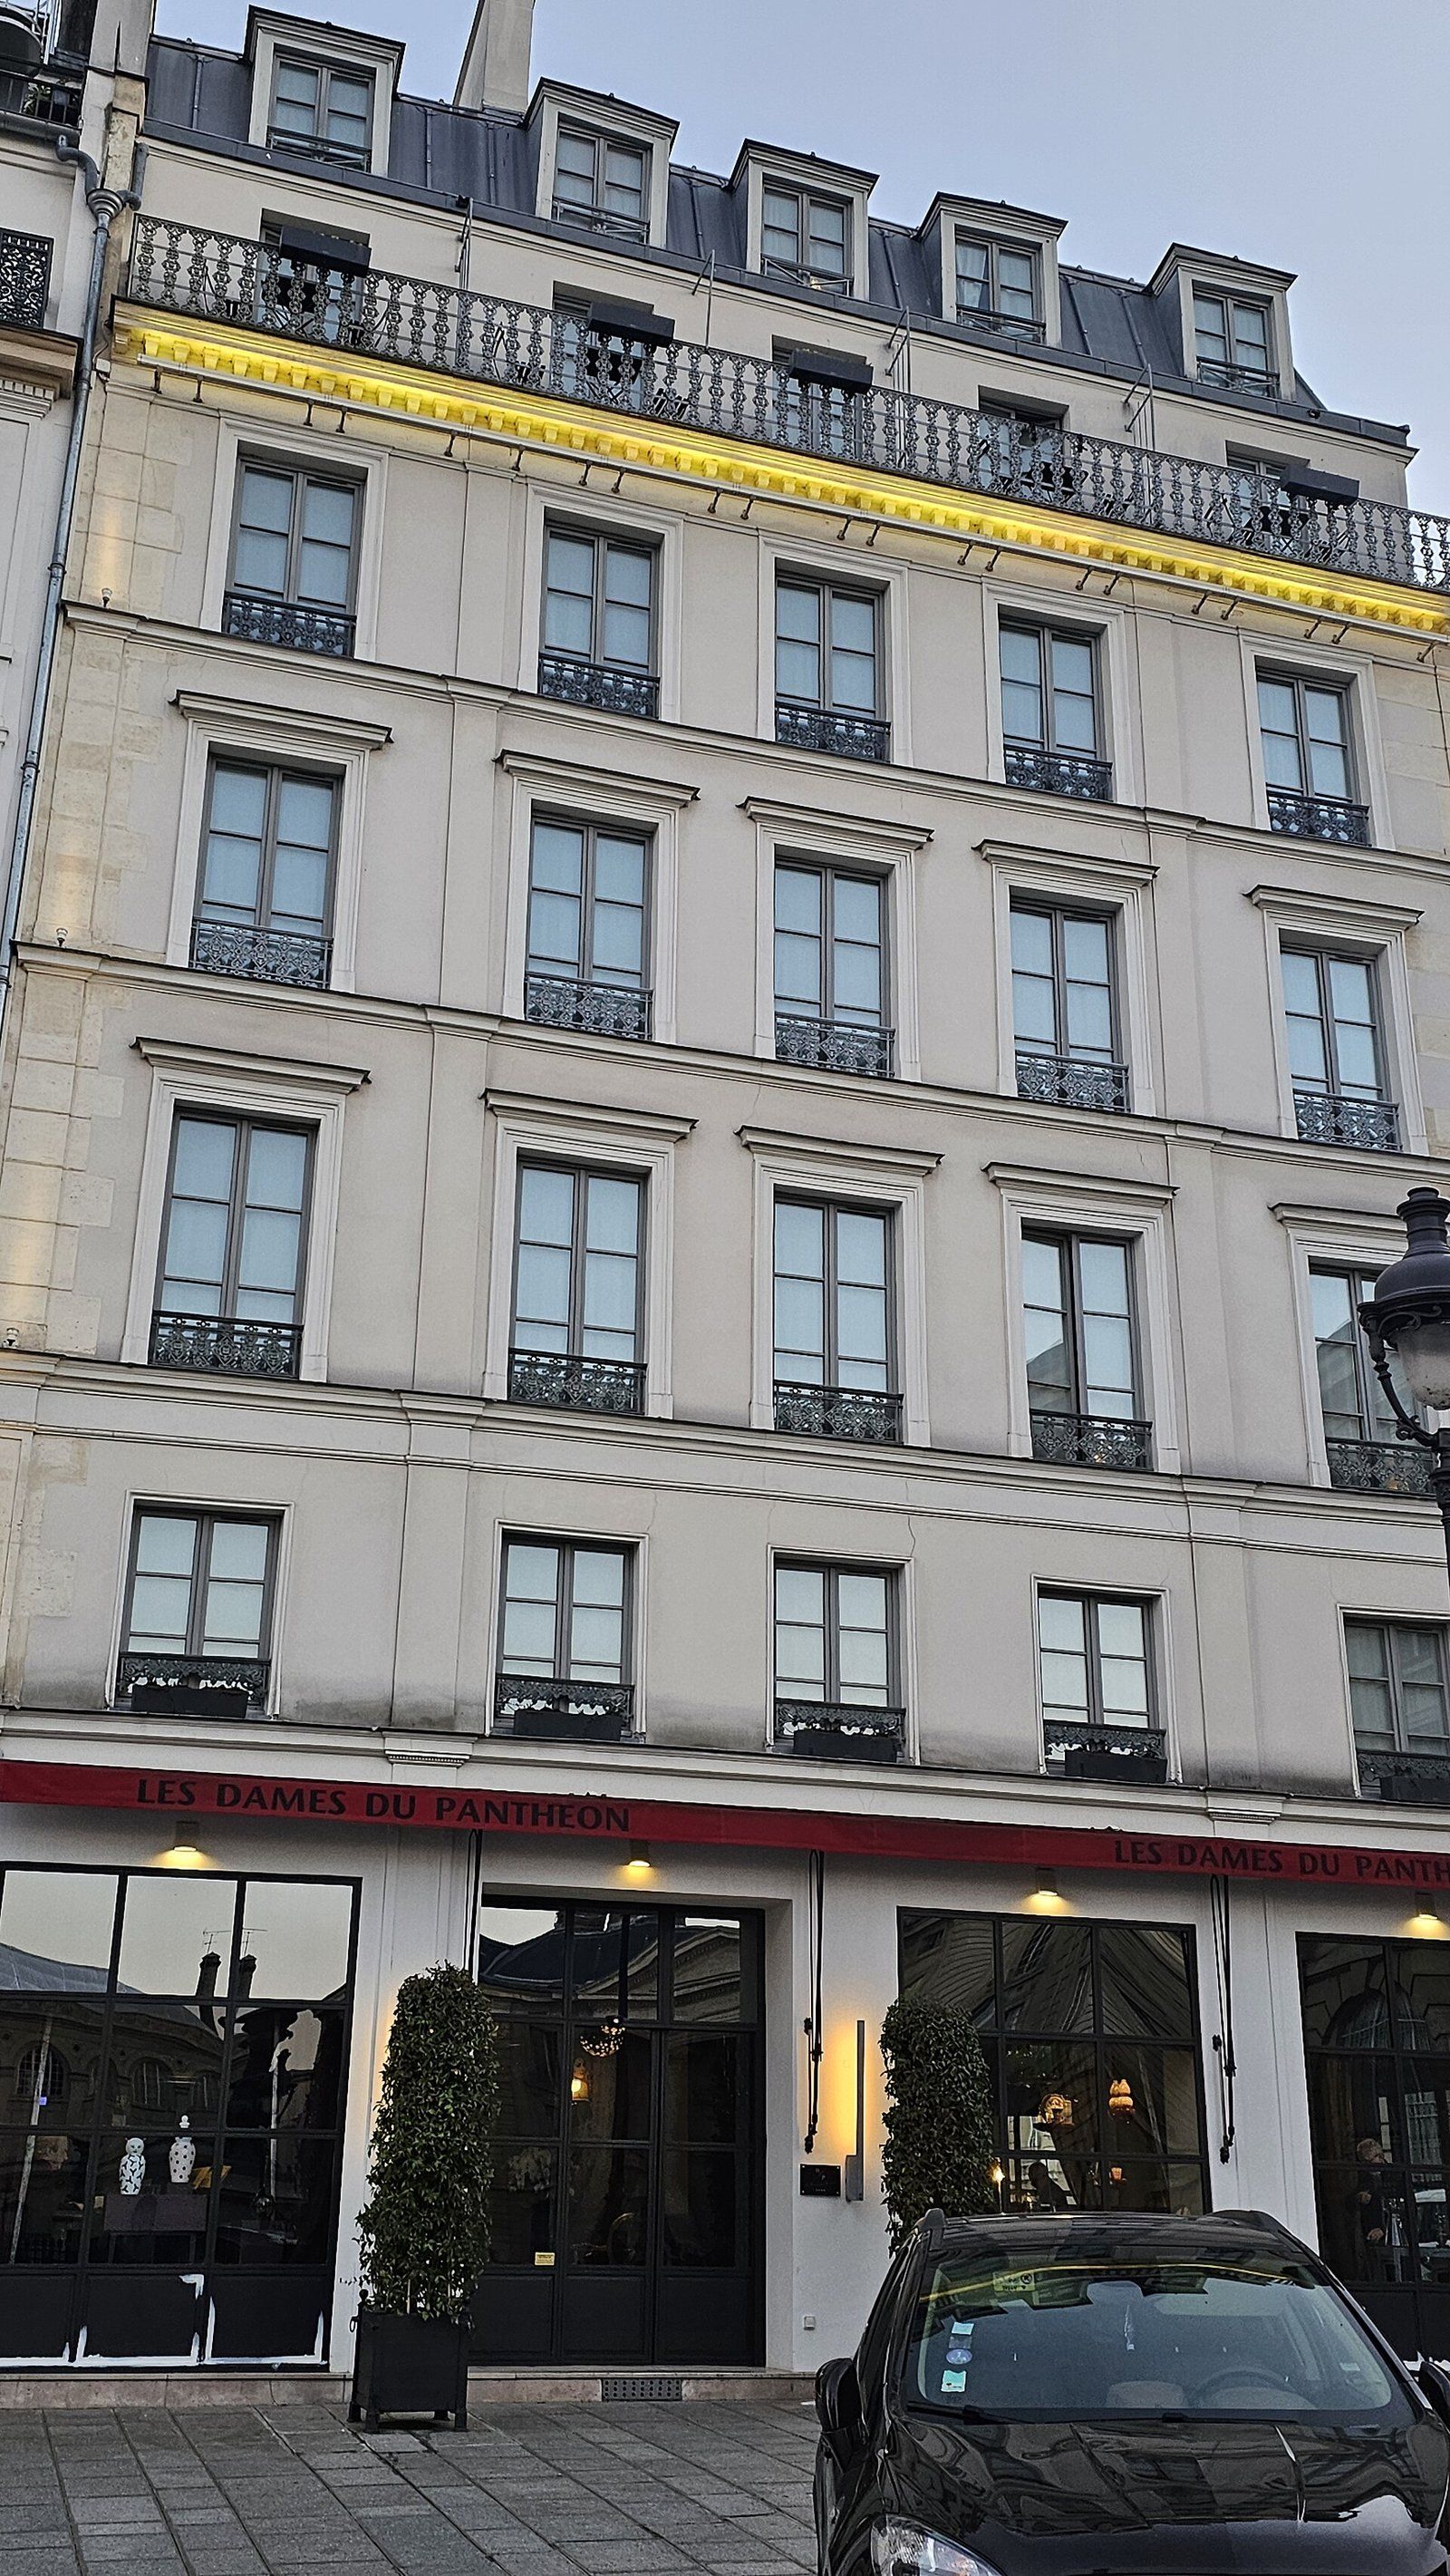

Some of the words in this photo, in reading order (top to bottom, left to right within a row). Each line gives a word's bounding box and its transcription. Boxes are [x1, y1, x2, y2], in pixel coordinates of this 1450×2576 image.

[138, 1779, 195, 1806] LES
[217, 1783, 346, 1815] DAMES
[367, 1793, 416, 1819] DU
[436, 1799, 630, 1831] PANTHEON
[1115, 1840, 1162, 1864] LES
[1180, 1844, 1283, 1873] DAMES
[1300, 1852, 1340, 1876] DU
